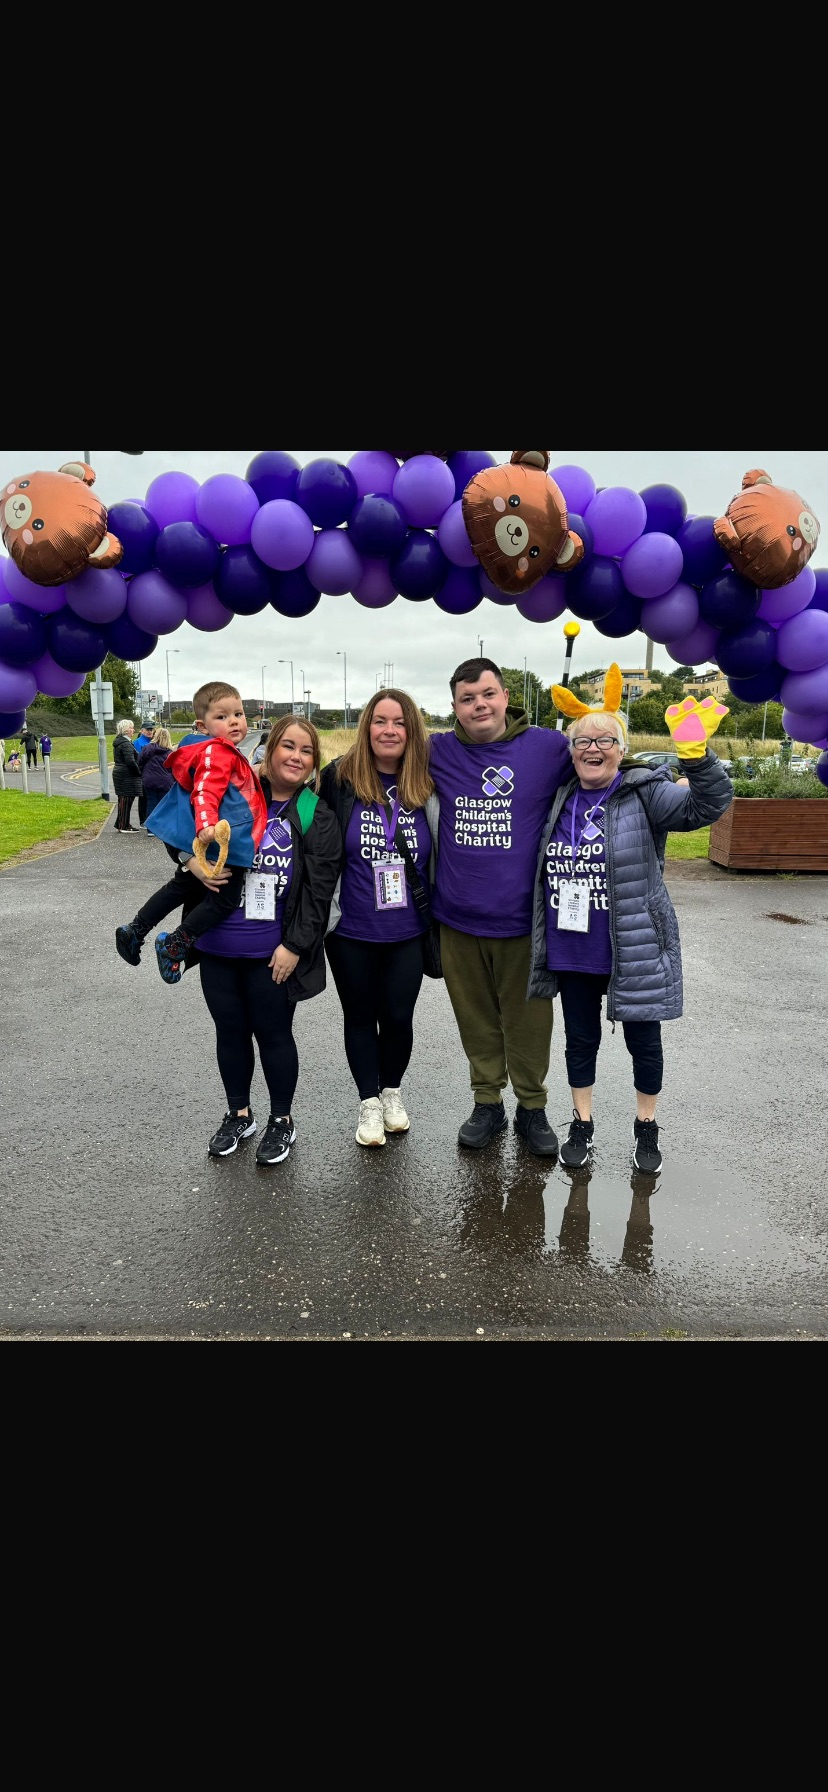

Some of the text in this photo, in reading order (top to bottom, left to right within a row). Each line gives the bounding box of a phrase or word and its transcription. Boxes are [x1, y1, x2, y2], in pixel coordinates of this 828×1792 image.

[455, 796, 512, 811] Glasgow
[360, 810, 415, 825] Glaow
[455, 809, 512, 820] Children's
[360, 823, 417, 836] Chiln's
[455, 820, 512, 835] Hospital
[360, 834, 418, 849] Hosal
[455, 832, 512, 849] Charity
[360, 846, 418, 863] Chary
[546, 841, 603, 860] Glasgo
[546, 860, 606, 874] Children
